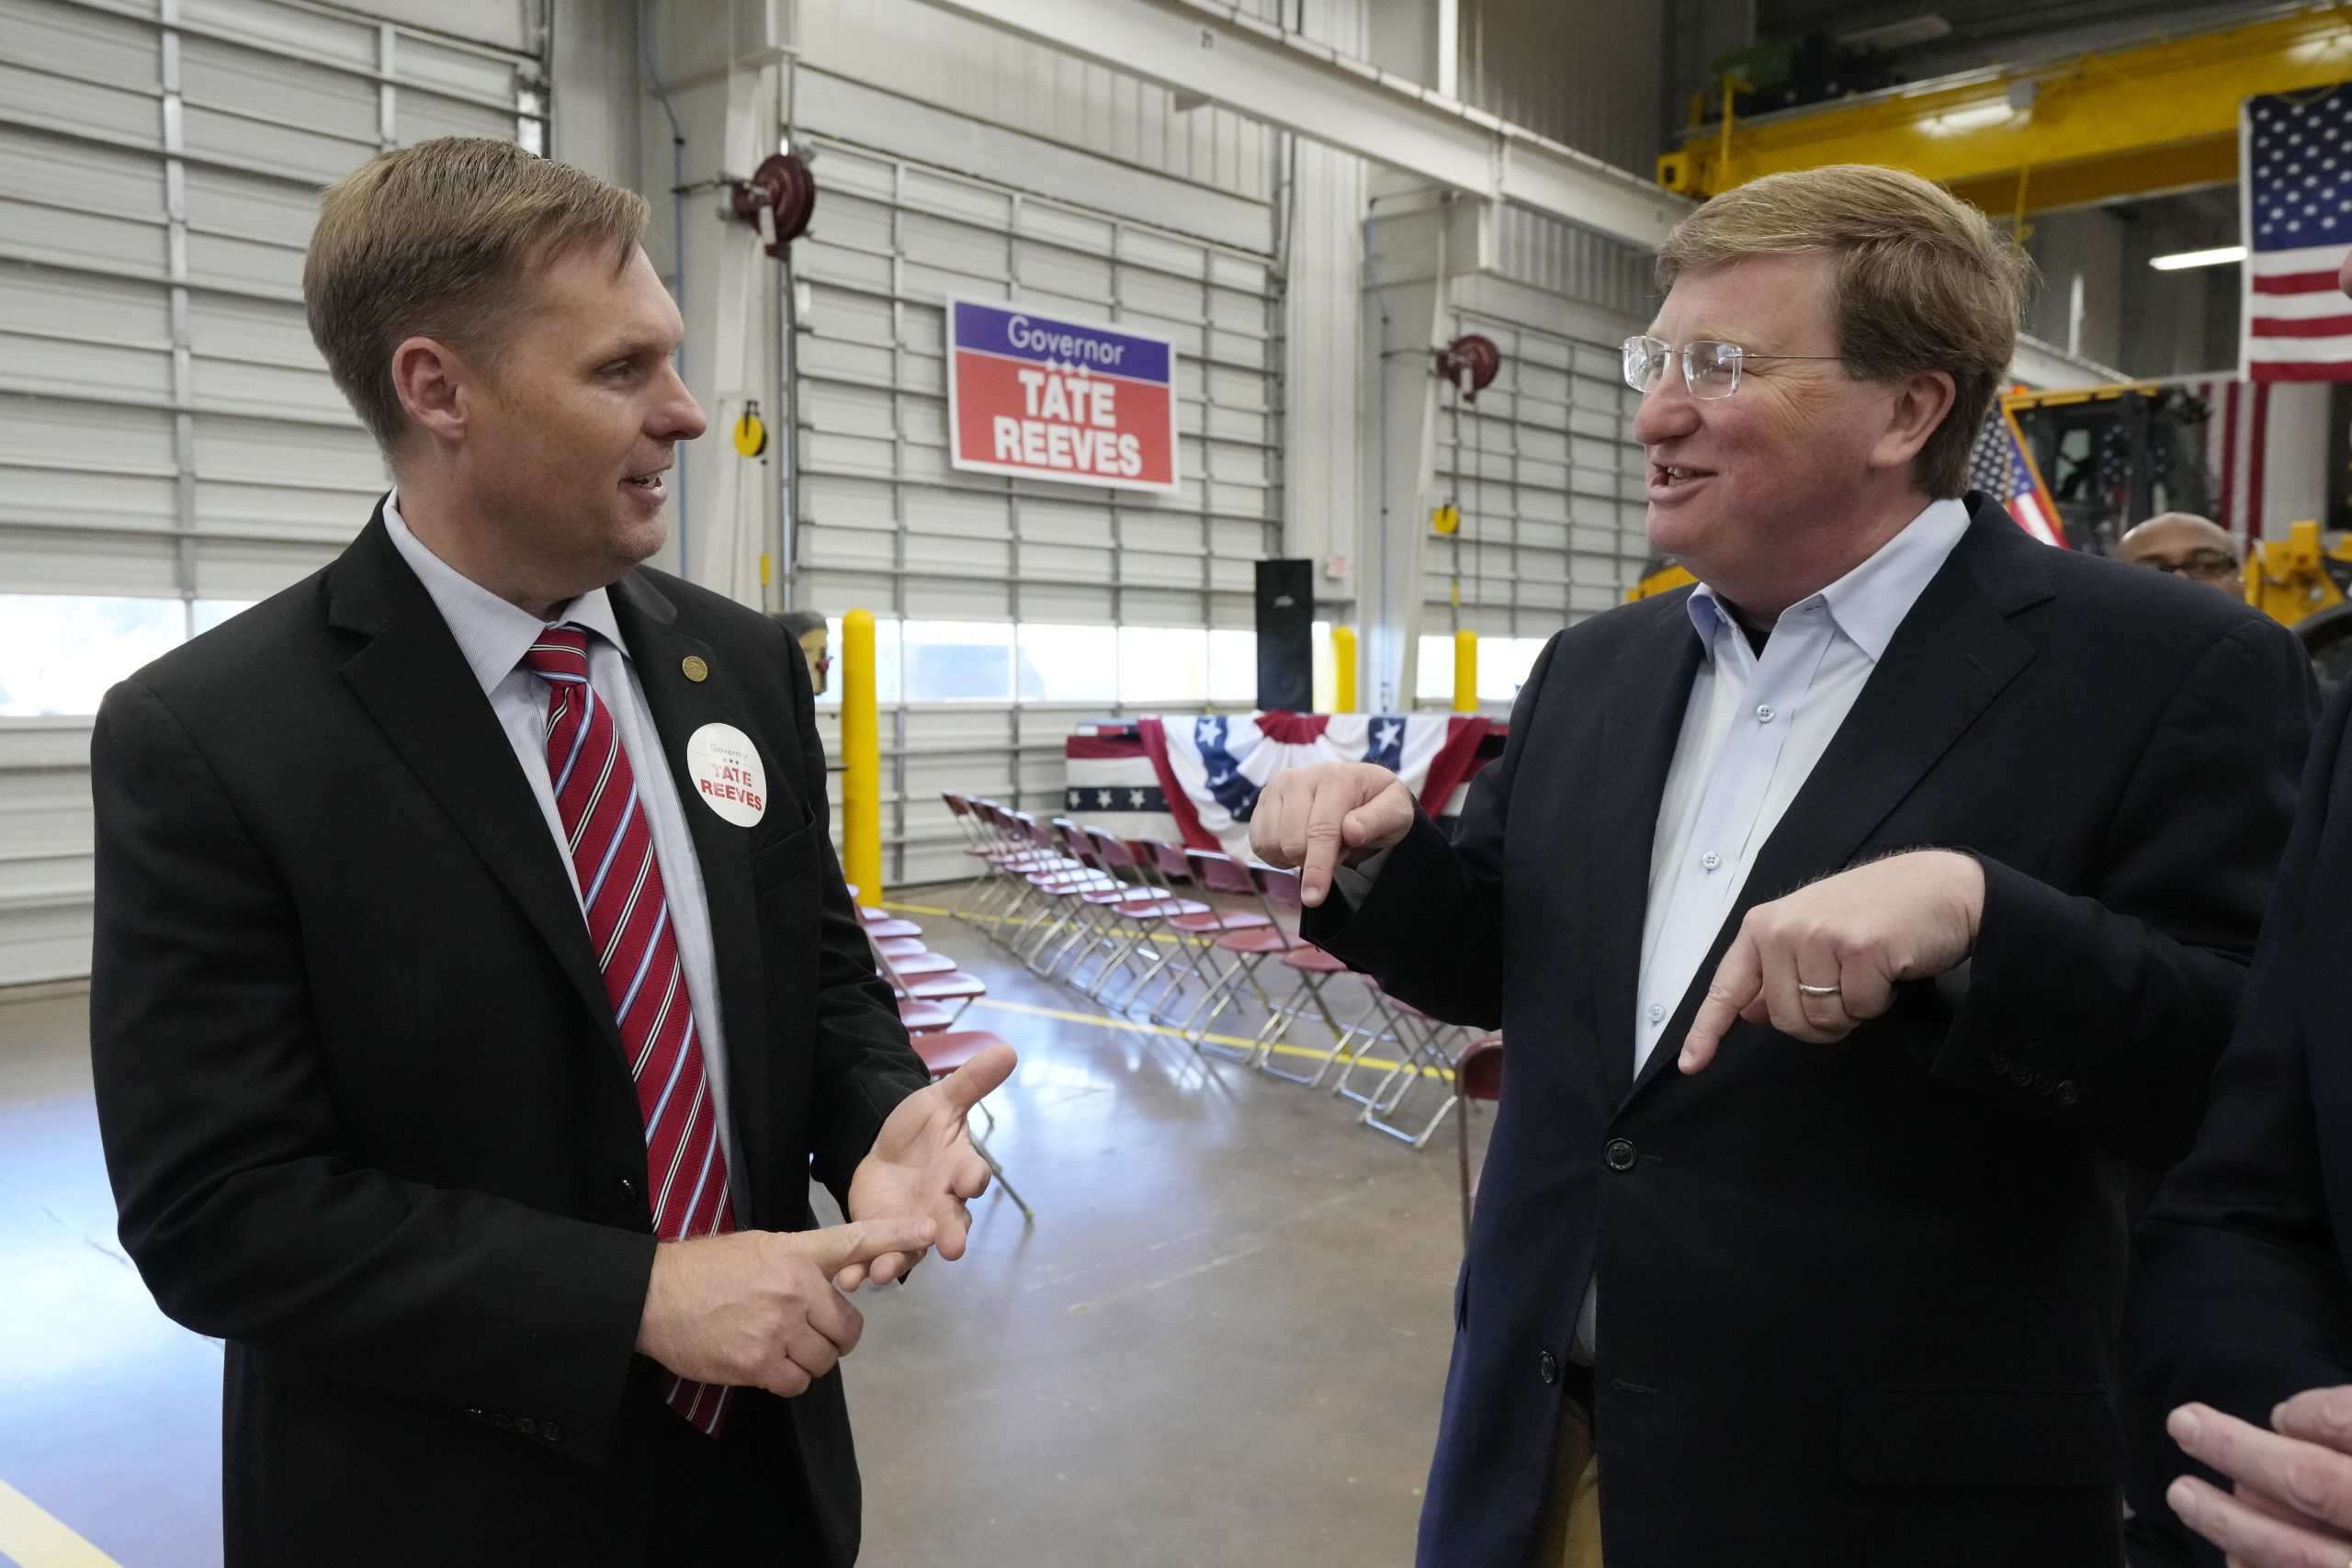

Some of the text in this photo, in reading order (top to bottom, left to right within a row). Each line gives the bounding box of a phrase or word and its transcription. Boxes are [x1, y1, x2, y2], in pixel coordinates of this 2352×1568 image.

[1008, 315, 1125, 365] Governor
[1018, 368, 1116, 427] TATE
[993, 415, 1142, 476] REEVES
[700, 779, 762, 811] REEVES
[711, 762, 752, 787] TATE
